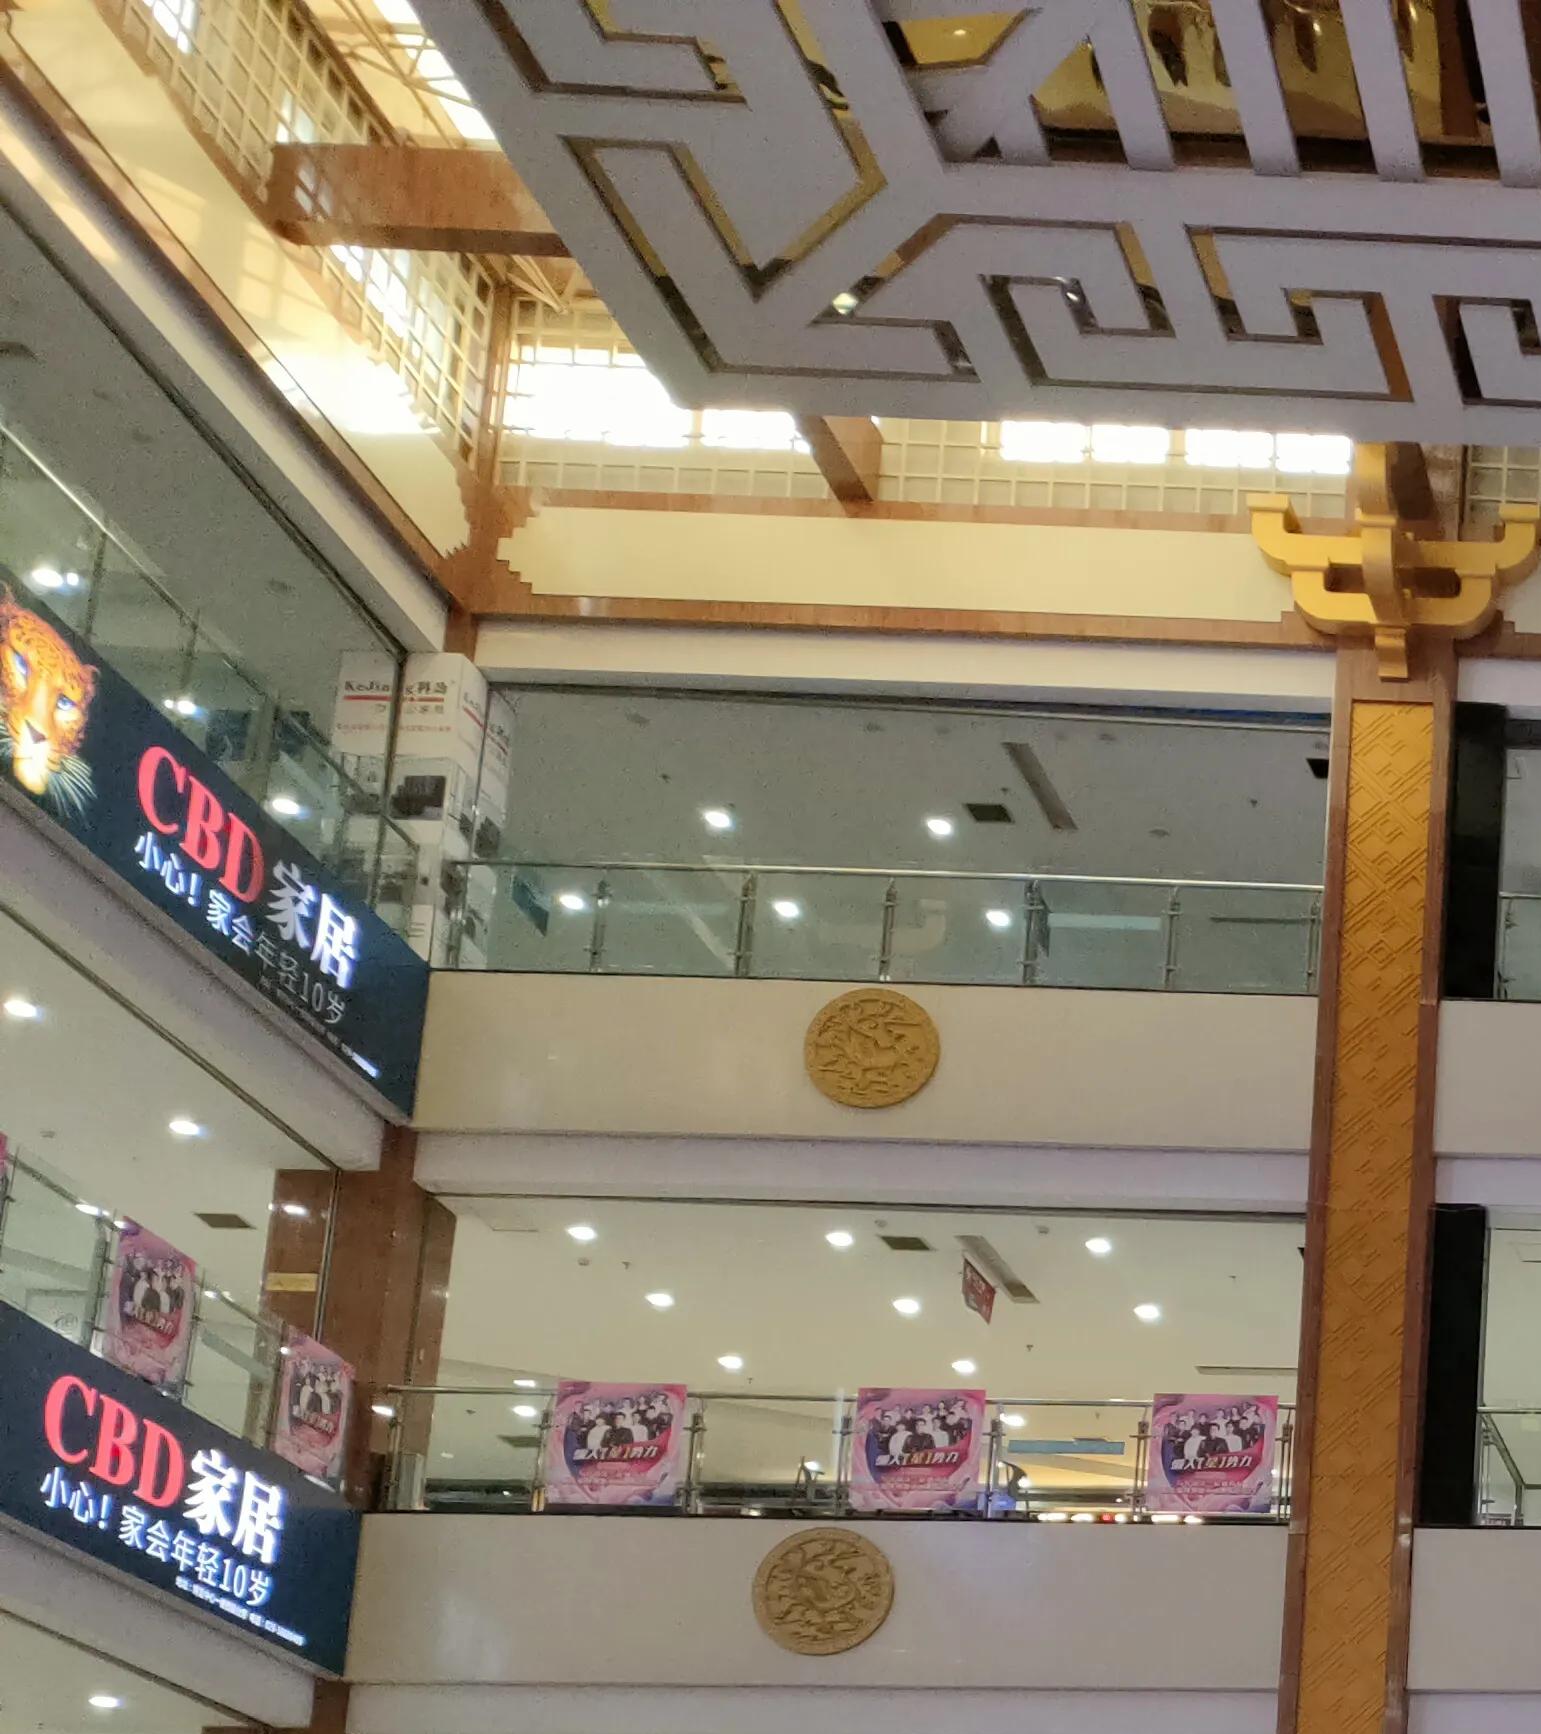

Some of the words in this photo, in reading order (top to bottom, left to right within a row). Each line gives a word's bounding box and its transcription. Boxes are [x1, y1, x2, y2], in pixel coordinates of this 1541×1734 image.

[40, 1465, 273, 1607] 小心！家会年轻10岁
[44, 1375, 286, 1565] CBD家居
